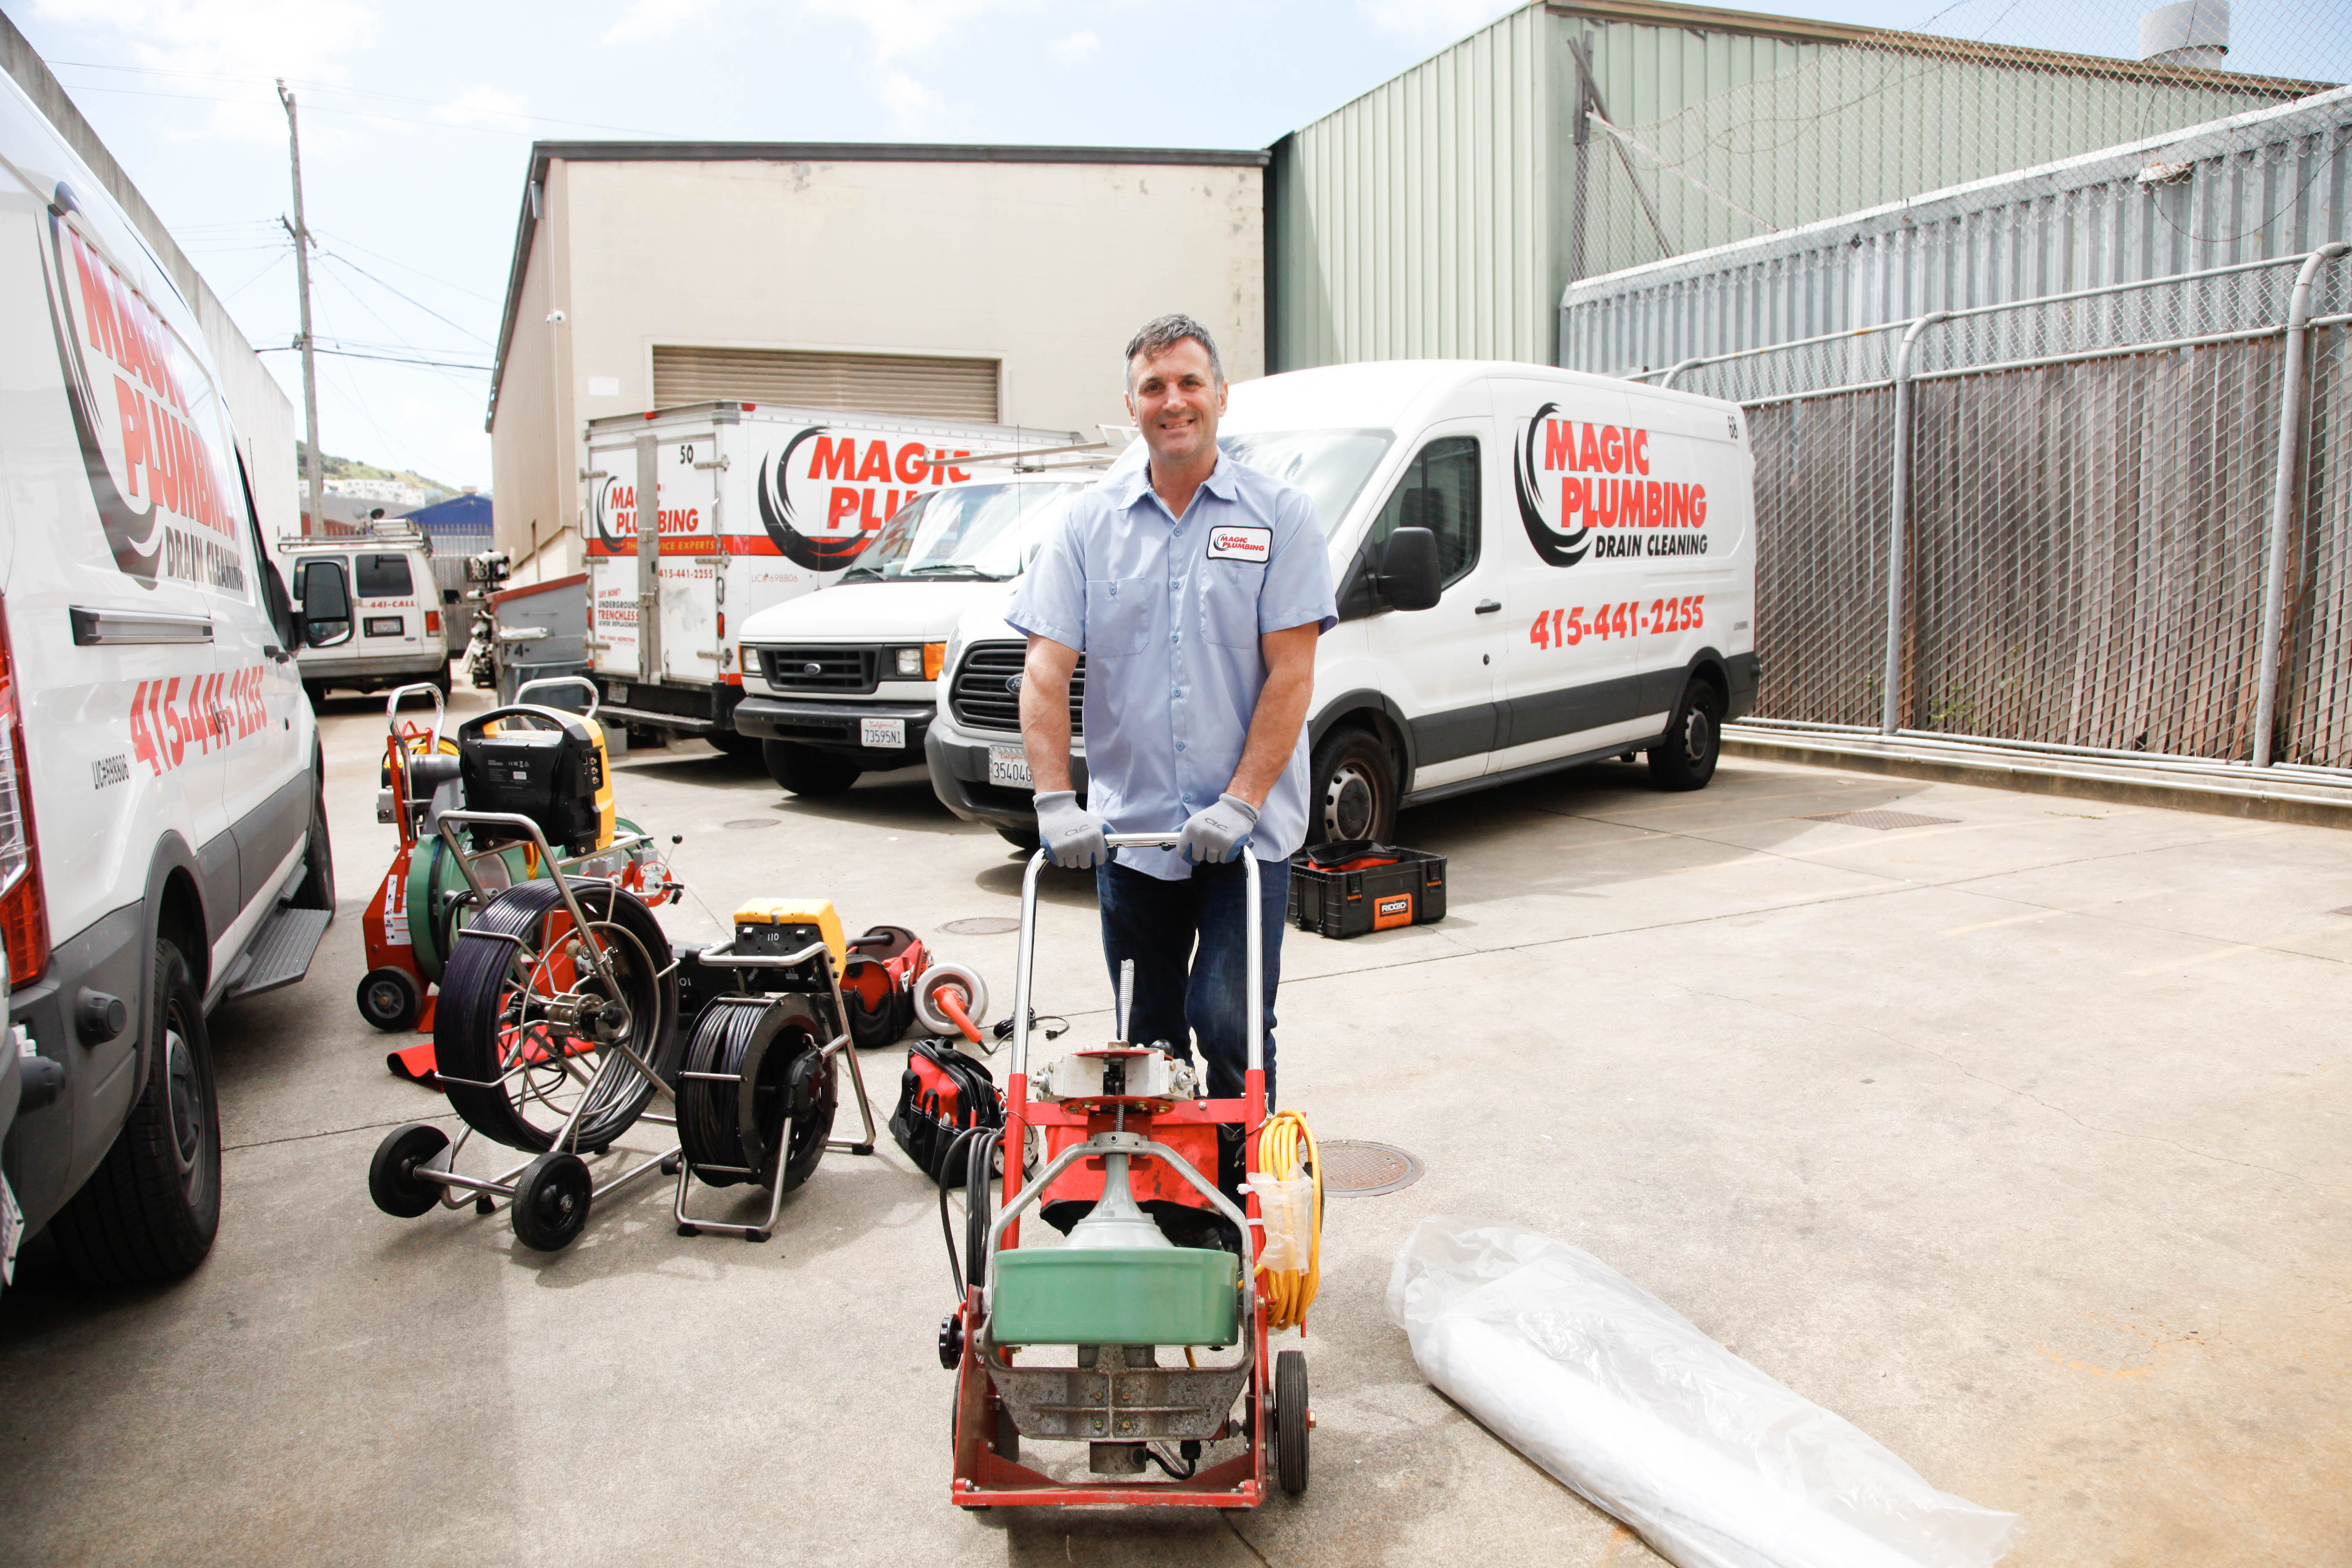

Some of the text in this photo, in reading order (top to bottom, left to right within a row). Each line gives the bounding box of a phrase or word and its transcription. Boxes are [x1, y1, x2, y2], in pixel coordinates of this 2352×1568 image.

[1728, 415, 1738, 440] 68
[113, 373, 236, 541] PLUMBING
[680, 445, 694, 464] 50
[1545, 419, 1649, 475] MAGIC
[1561, 477, 1707, 528] PLUMBING
[616, 508, 699, 534] PLUBING
[678, 540, 715, 549] EXPERTS
[1222, 542, 1265, 551] PLUMBING
[1595, 534, 1707, 558] DRAIN CLEANING
[165, 526, 243, 593] DRAIN CLEANING
[659, 569, 713, 578] 415-441-2255
[1530, 595, 1704, 650] 415-441-2255
[130, 665, 267, 777] 415-441-2255
[864, 729, 901, 744] 73595N1
[994, 762, 1032, 782] 35404G
[1382, 902, 1406, 912] RIDGID
